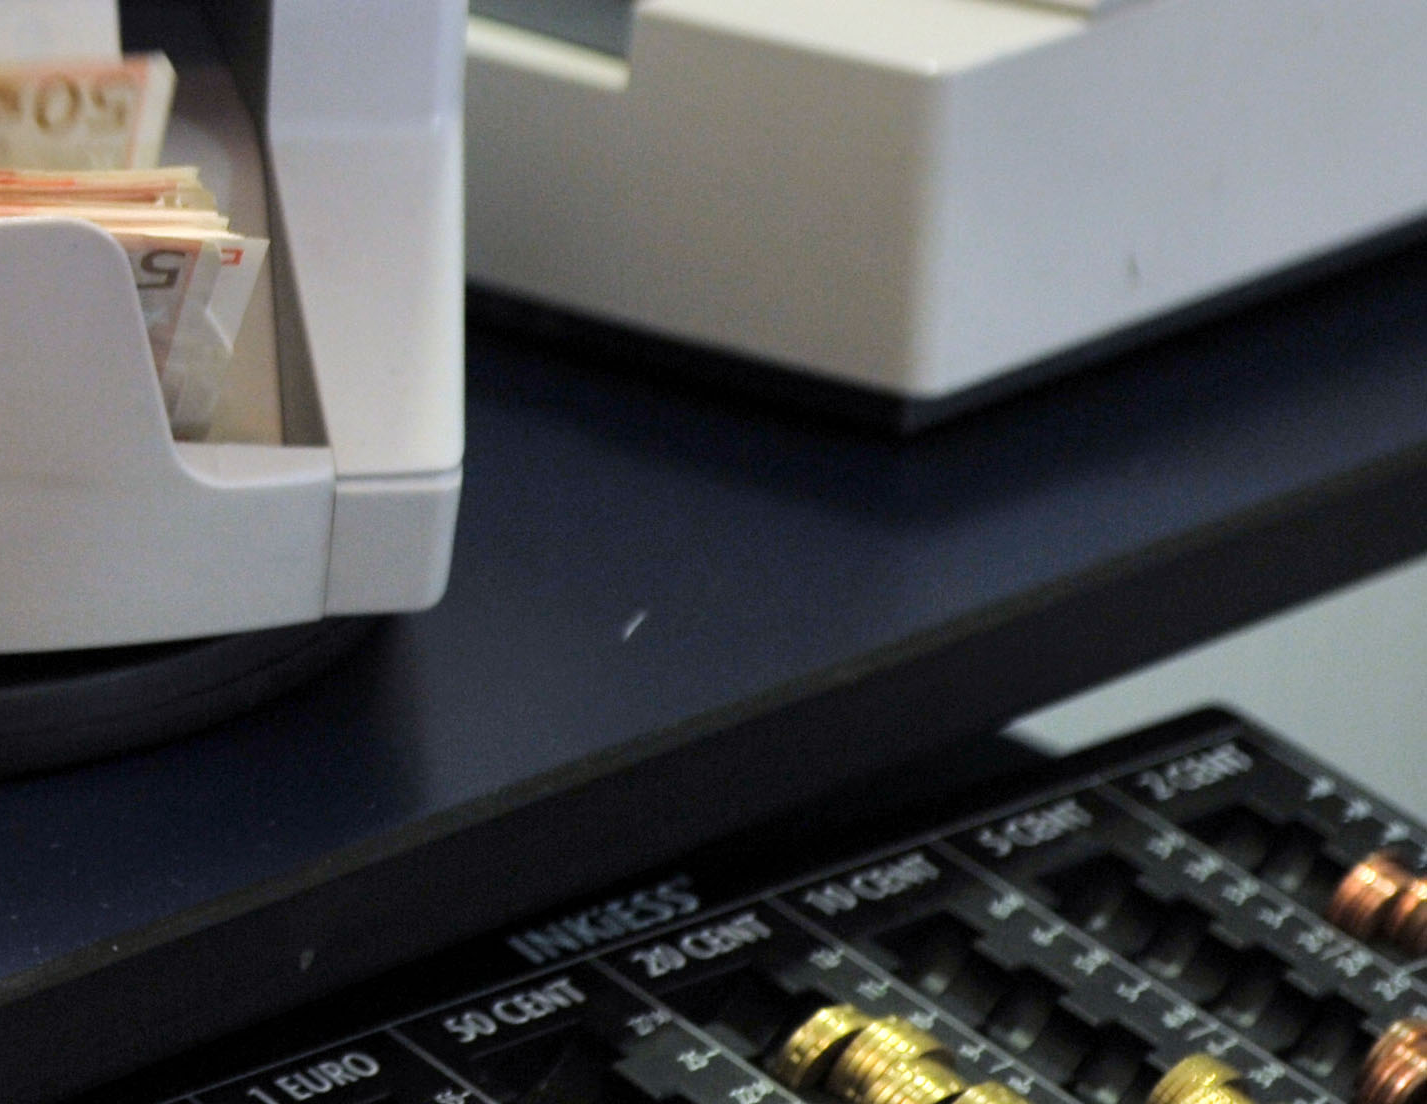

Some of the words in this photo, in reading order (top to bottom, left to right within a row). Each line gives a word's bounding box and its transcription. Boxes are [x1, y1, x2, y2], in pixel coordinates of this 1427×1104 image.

[850, 852, 940, 900] CENT
[680, 911, 772, 960] CENT
[441, 1010, 499, 1044] 50
[491, 976, 587, 1026] CENT
[273, 1051, 381, 1102] EURO
